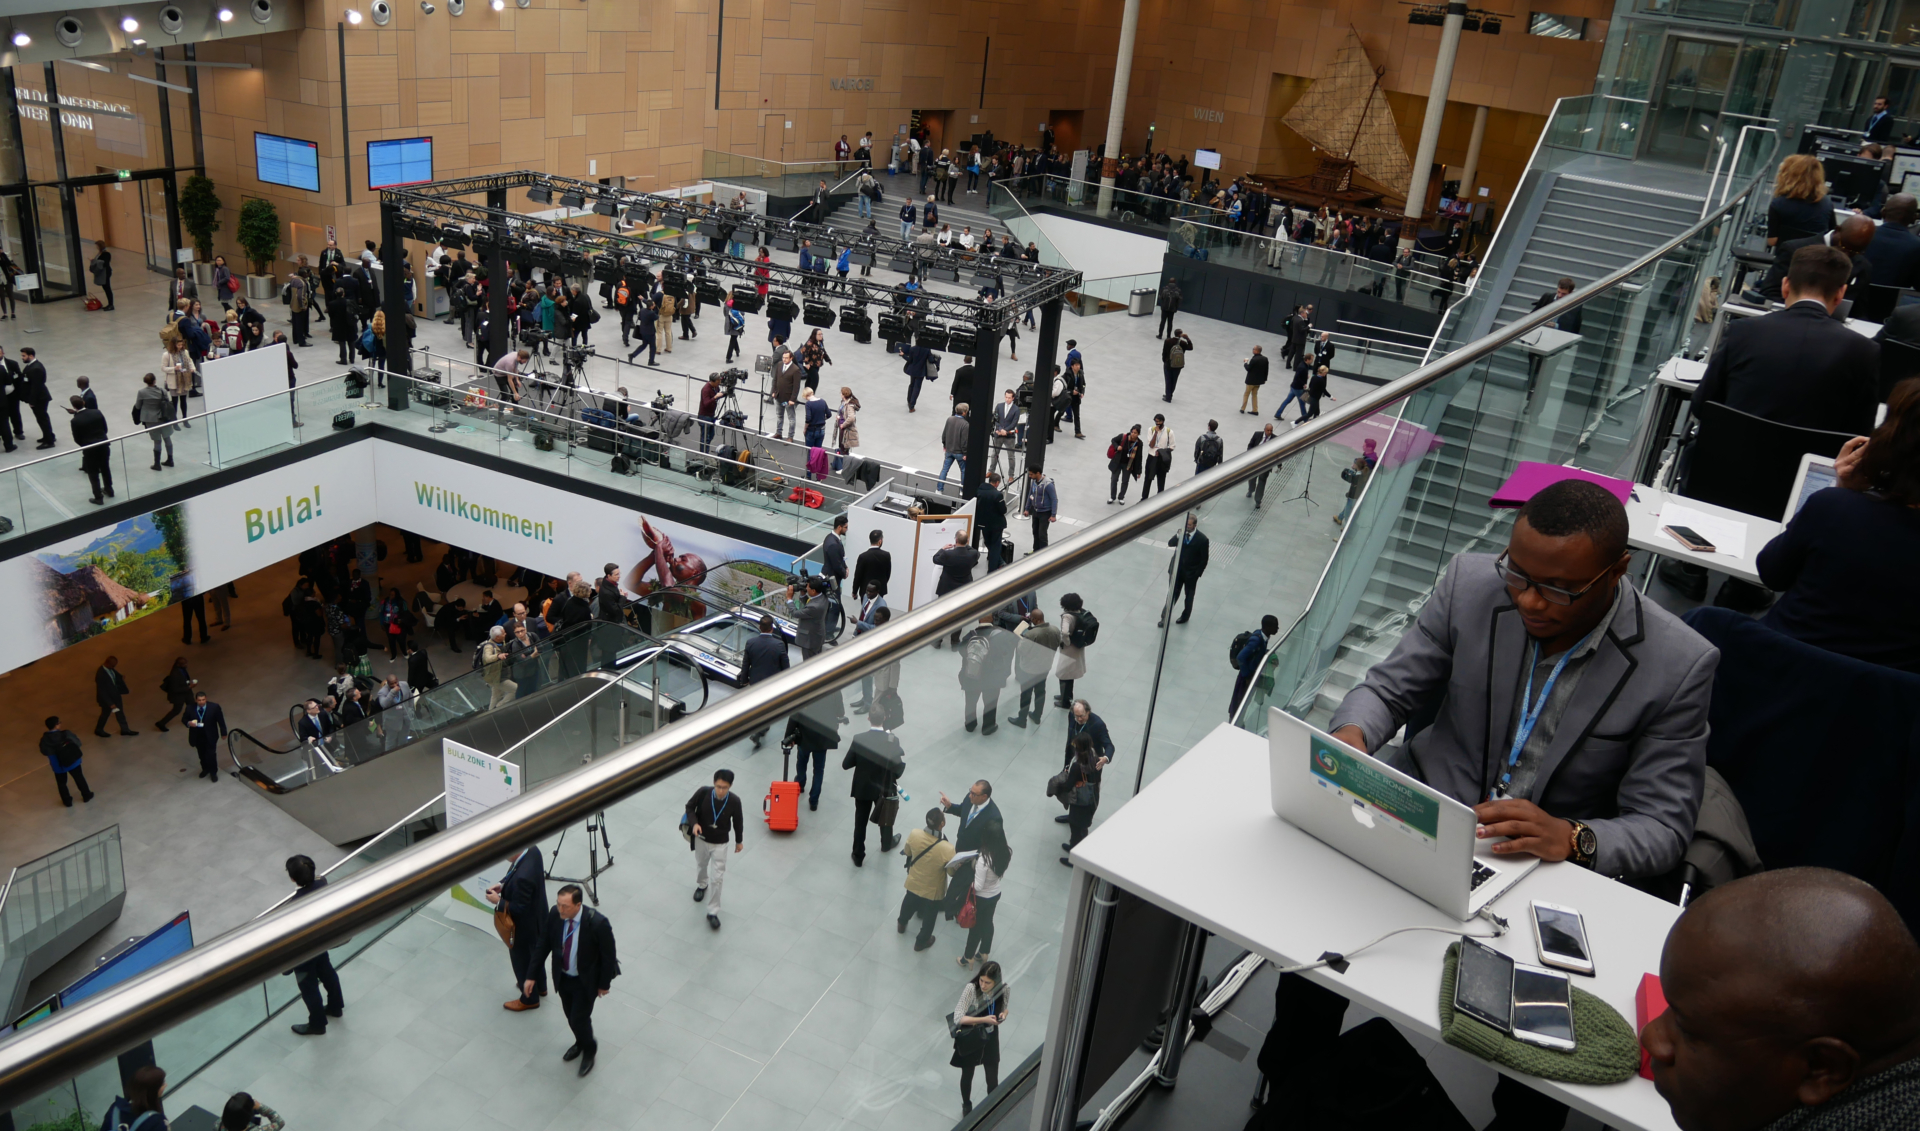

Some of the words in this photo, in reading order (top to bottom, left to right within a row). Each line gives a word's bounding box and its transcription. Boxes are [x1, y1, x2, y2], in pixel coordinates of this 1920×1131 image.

[830, 77, 874, 91] NAIROBI
[1194, 107, 1224, 123] WIEN
[245, 485, 322, 544] Bula!
[414, 481, 554, 545] Willkommen!
[447, 747, 466, 761] BULA
[467, 755, 486, 769] ZONE
[488, 762, 492, 770] 1
[1356, 762, 1381, 781] TABLE
[1382, 777, 1413, 798] RONDE
